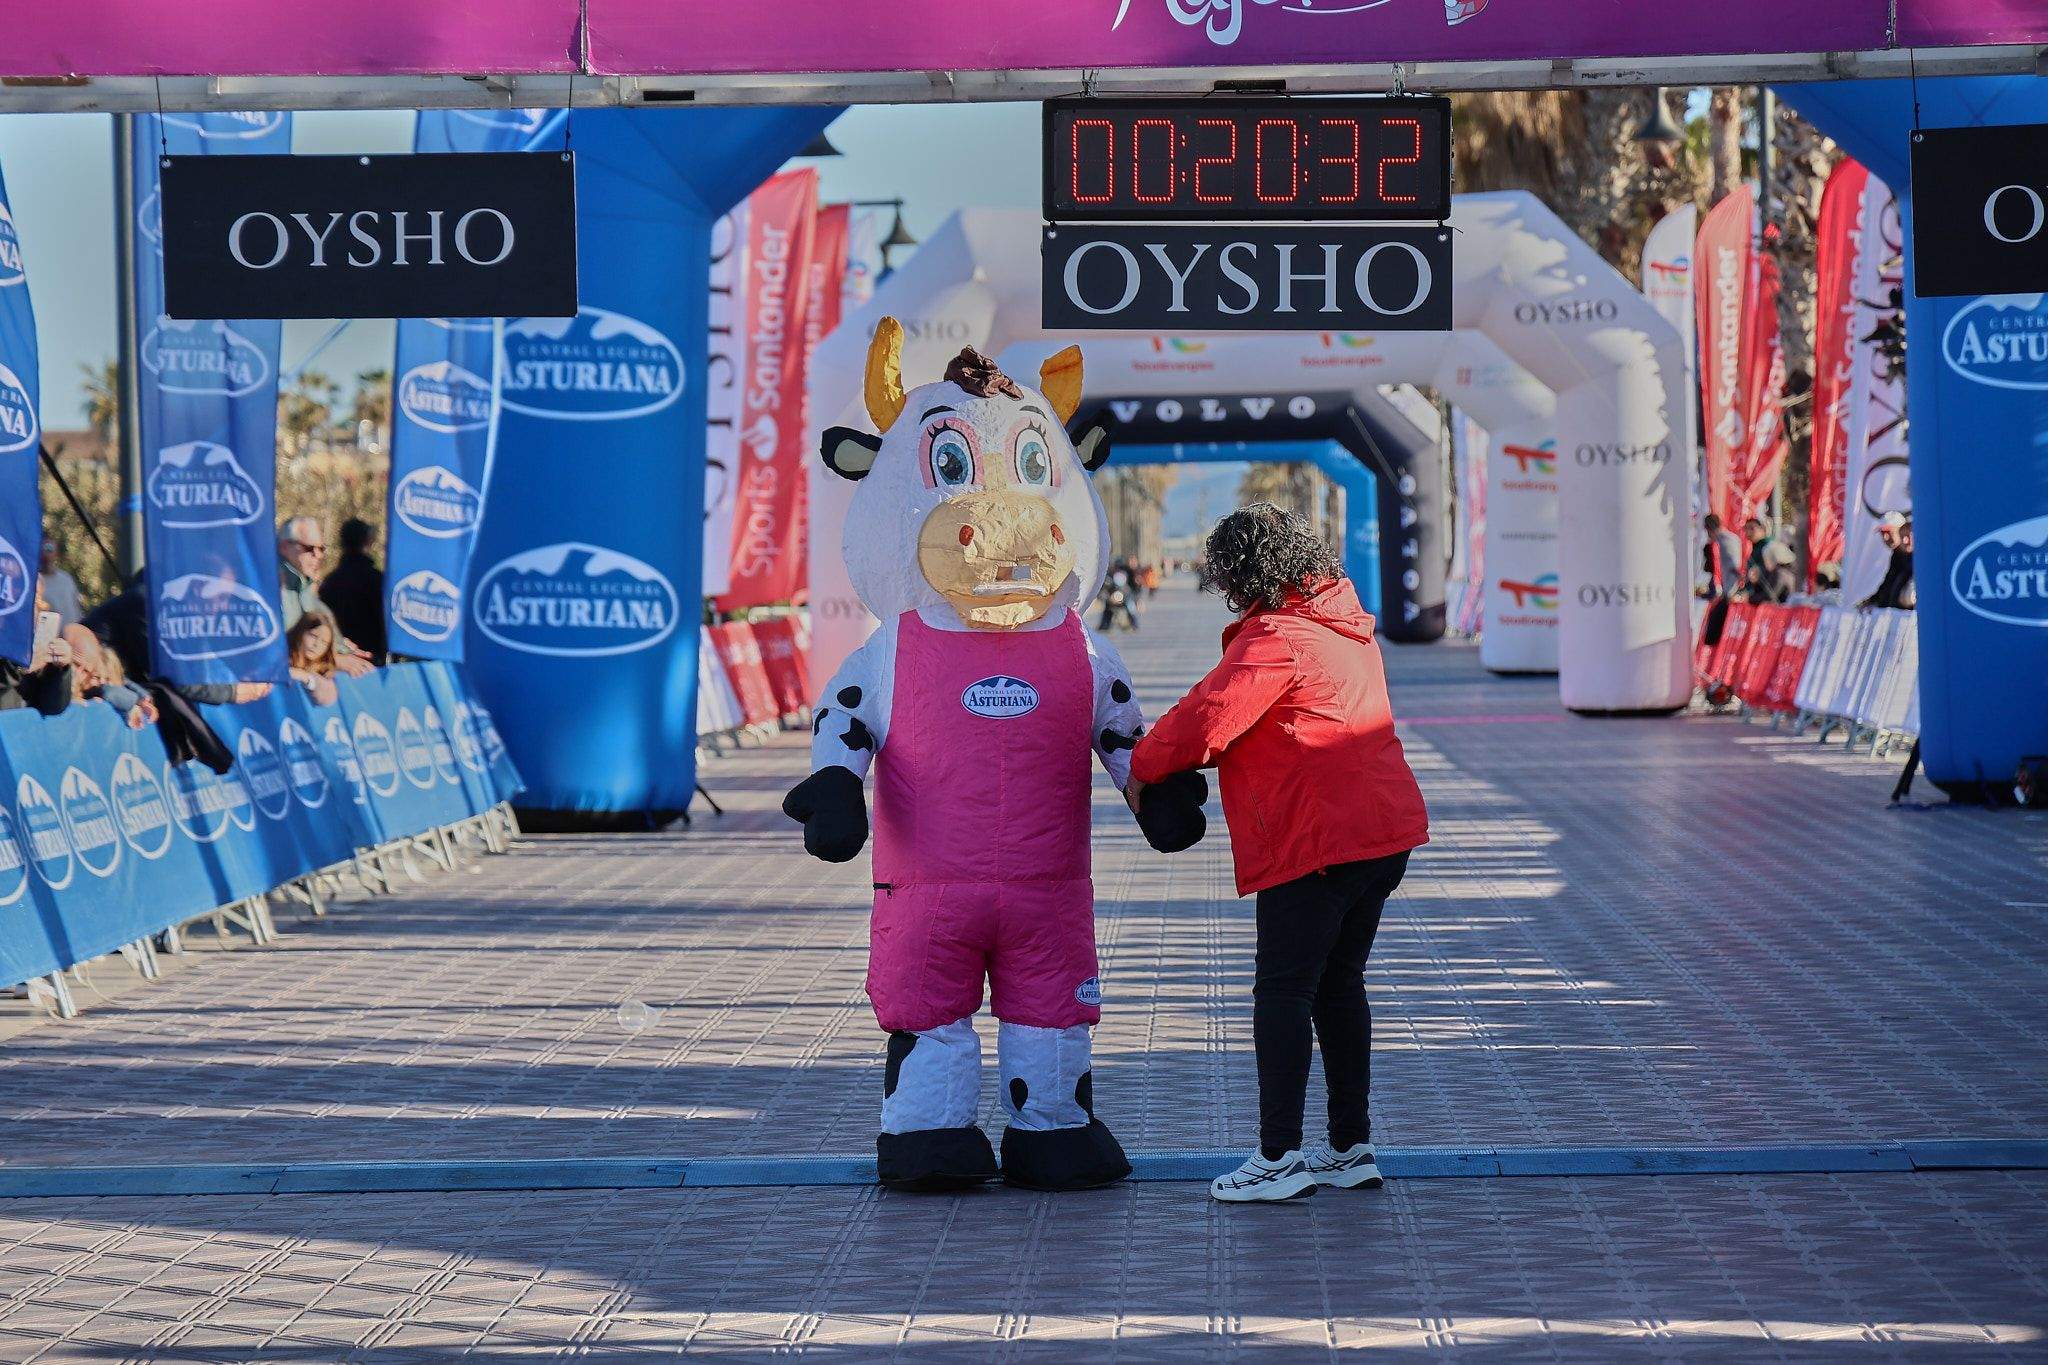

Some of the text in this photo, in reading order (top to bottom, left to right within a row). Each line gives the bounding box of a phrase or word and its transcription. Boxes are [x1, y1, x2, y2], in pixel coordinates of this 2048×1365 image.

[228, 207, 515, 269] OYSHO
[1063, 241, 1432, 315] OYSHO
[747, 222, 789, 409] Santander
[1514, 299, 1618, 325] OYSHO
[1717, 245, 1740, 407] Santander
[1110, 395, 1317, 423] VOLVO
[1575, 442, 1672, 467] OYSHO
[739, 465, 781, 577] Sports
[484, 581, 666, 630] ASTURIANA
[967, 690, 1034, 707] ASTURIANA
